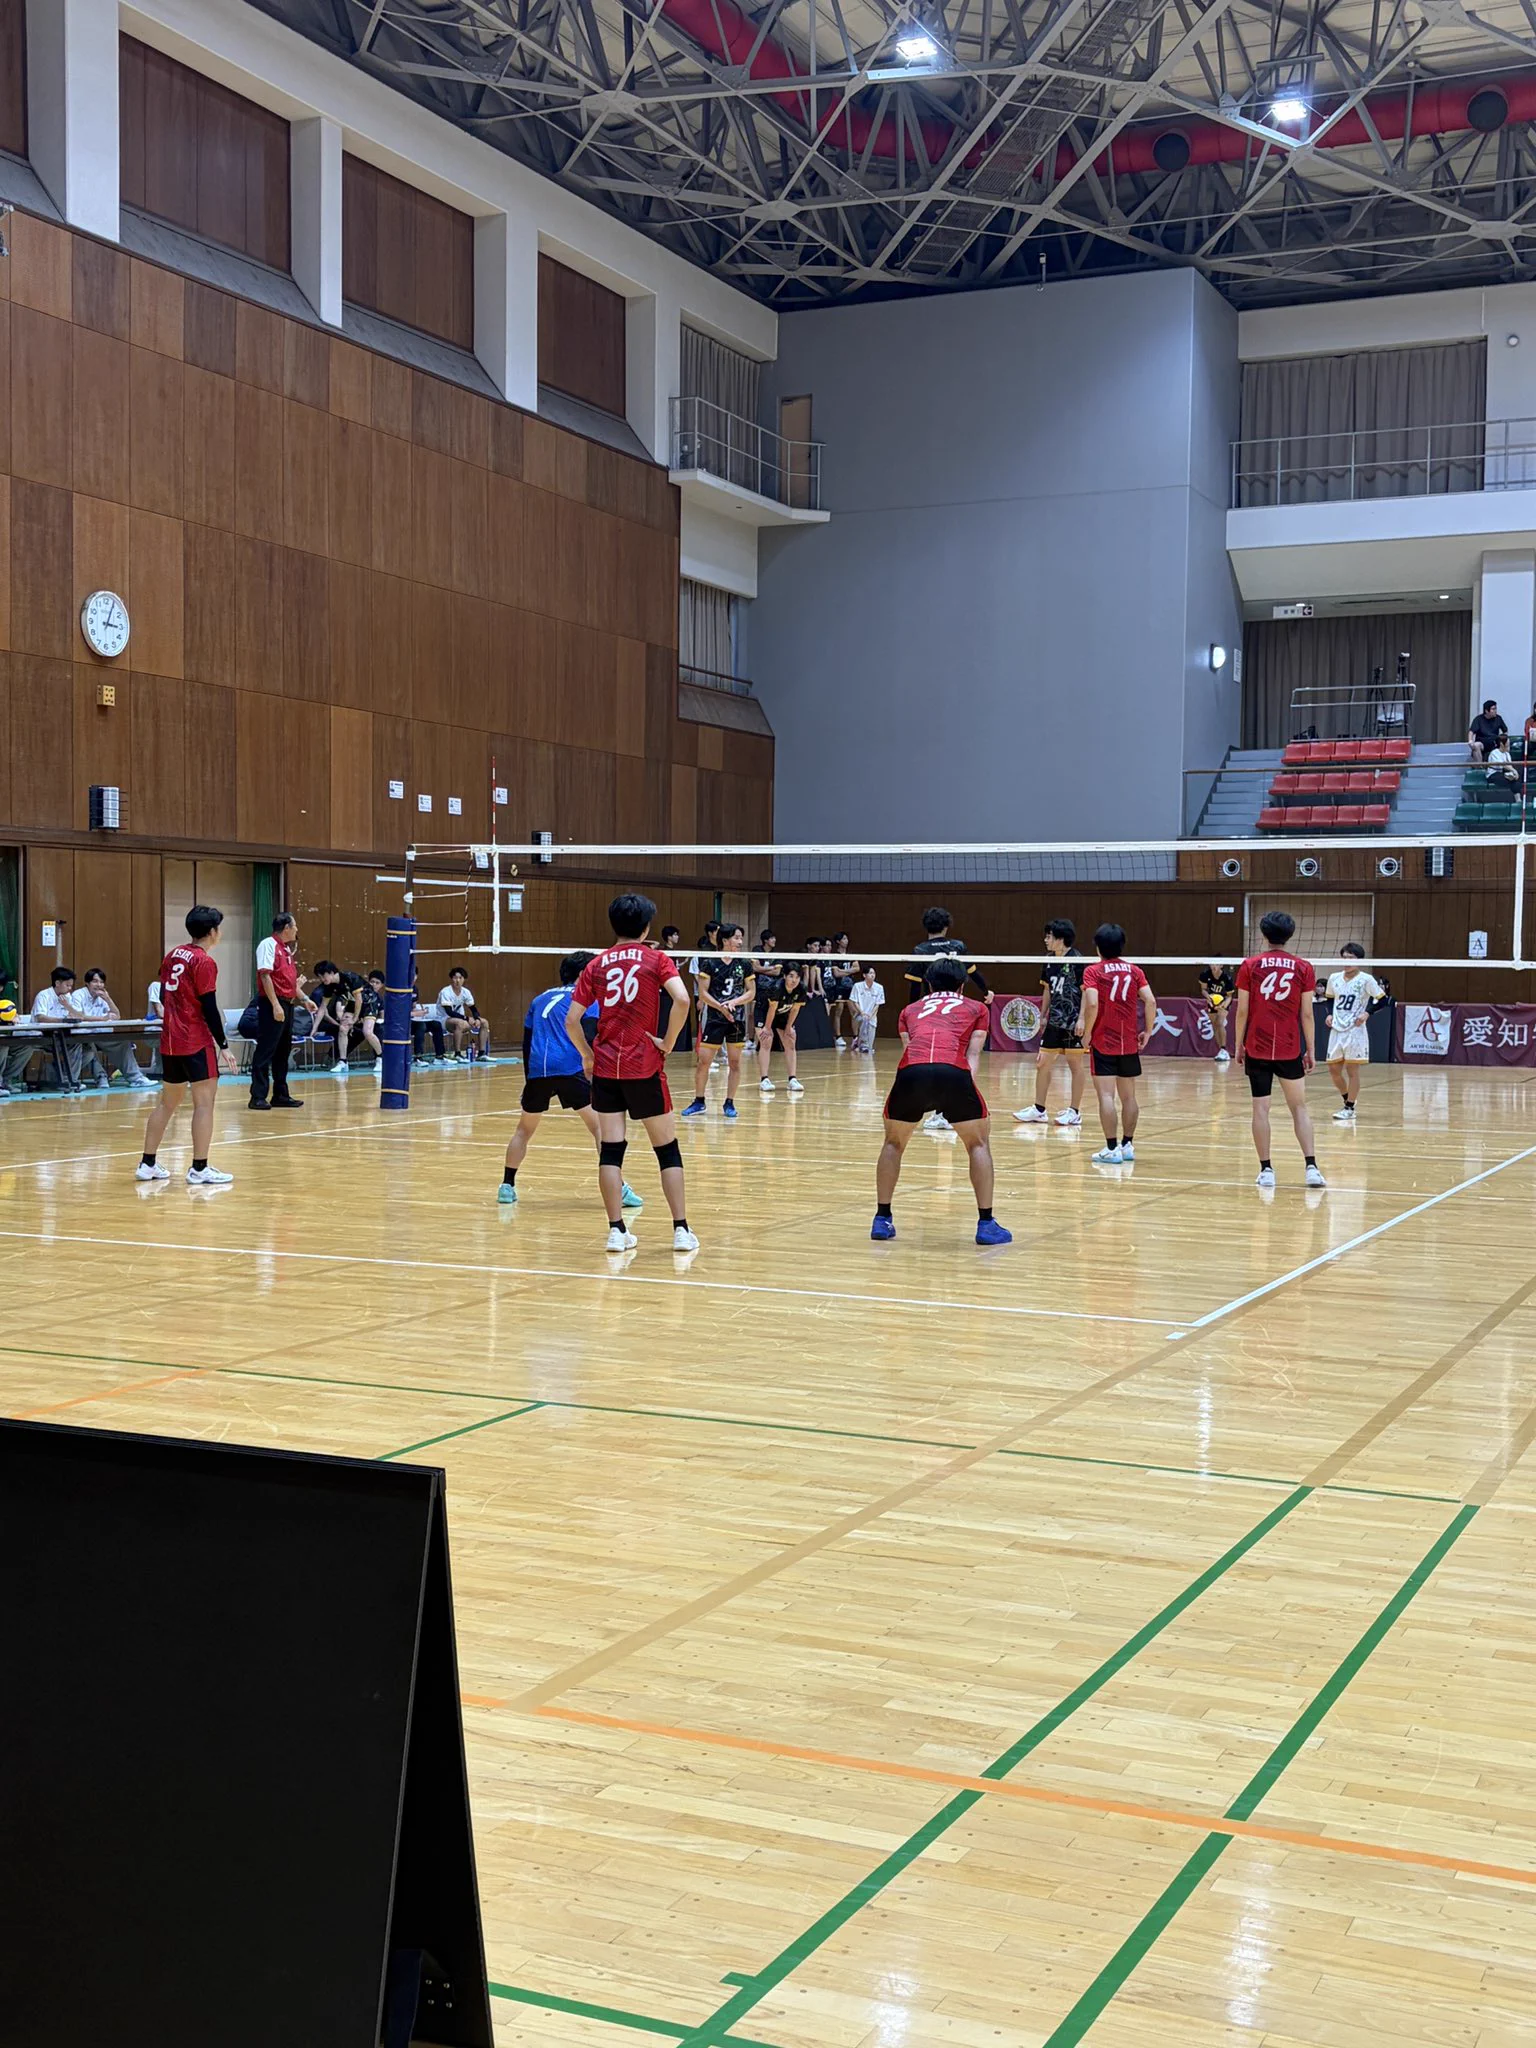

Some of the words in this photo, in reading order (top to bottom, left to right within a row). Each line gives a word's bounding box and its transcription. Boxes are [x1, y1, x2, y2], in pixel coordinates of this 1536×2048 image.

[1472, 938, 1484, 950] A
[601, 949, 643, 968] ASAHI
[1104, 963, 1132, 973] ASAHI
[1261, 957, 1296, 970] ASAHI
[165, 963, 185, 992] 3
[604, 964, 641, 1007] 36
[721, 978, 734, 996] 3
[1260, 971, 1295, 1001] 45
[1109, 974, 1131, 1002] 11
[917, 998, 963, 1019] 37
[1336, 994, 1356, 1010] 28
[1462, 1015, 1536, 1048] 愛知
